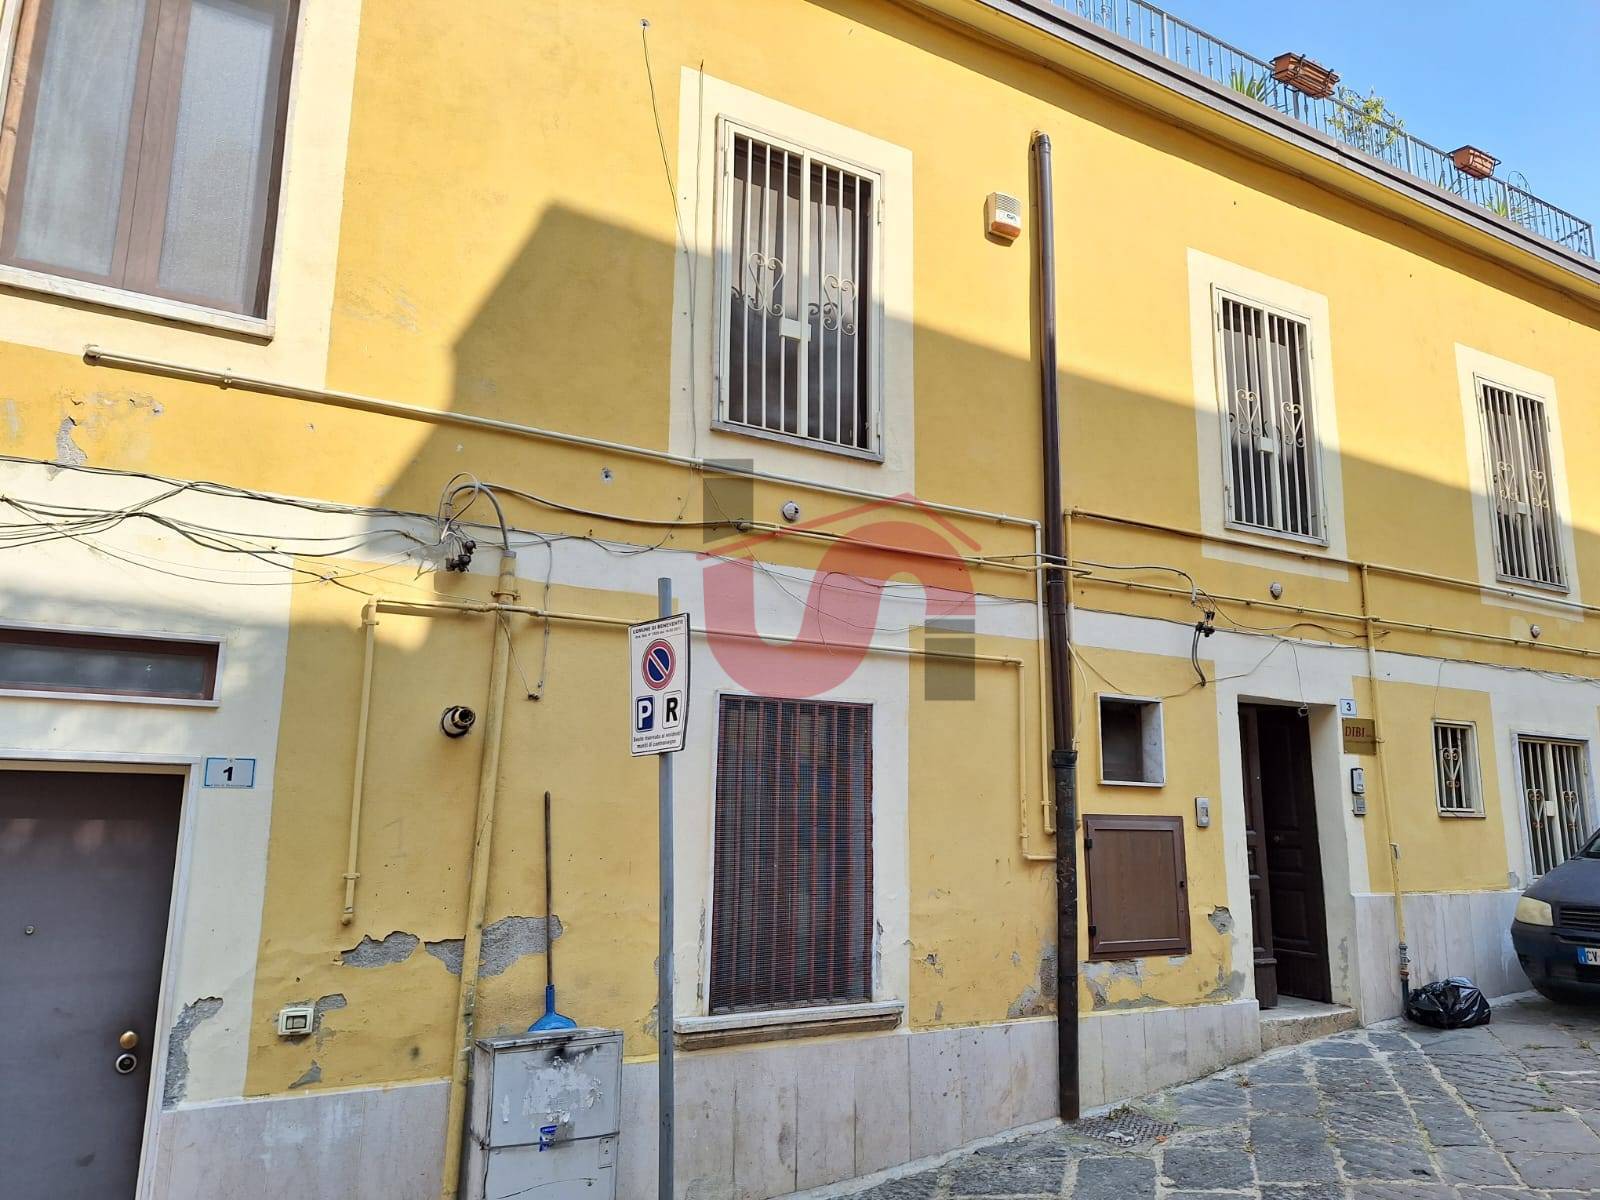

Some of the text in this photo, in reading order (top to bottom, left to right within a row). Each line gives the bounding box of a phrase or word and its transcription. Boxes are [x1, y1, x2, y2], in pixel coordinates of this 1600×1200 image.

[637, 700, 652, 729] P
[666, 697, 678, 722] R
[1346, 702, 1352, 711] 3
[223, 766, 233, 781] 1
